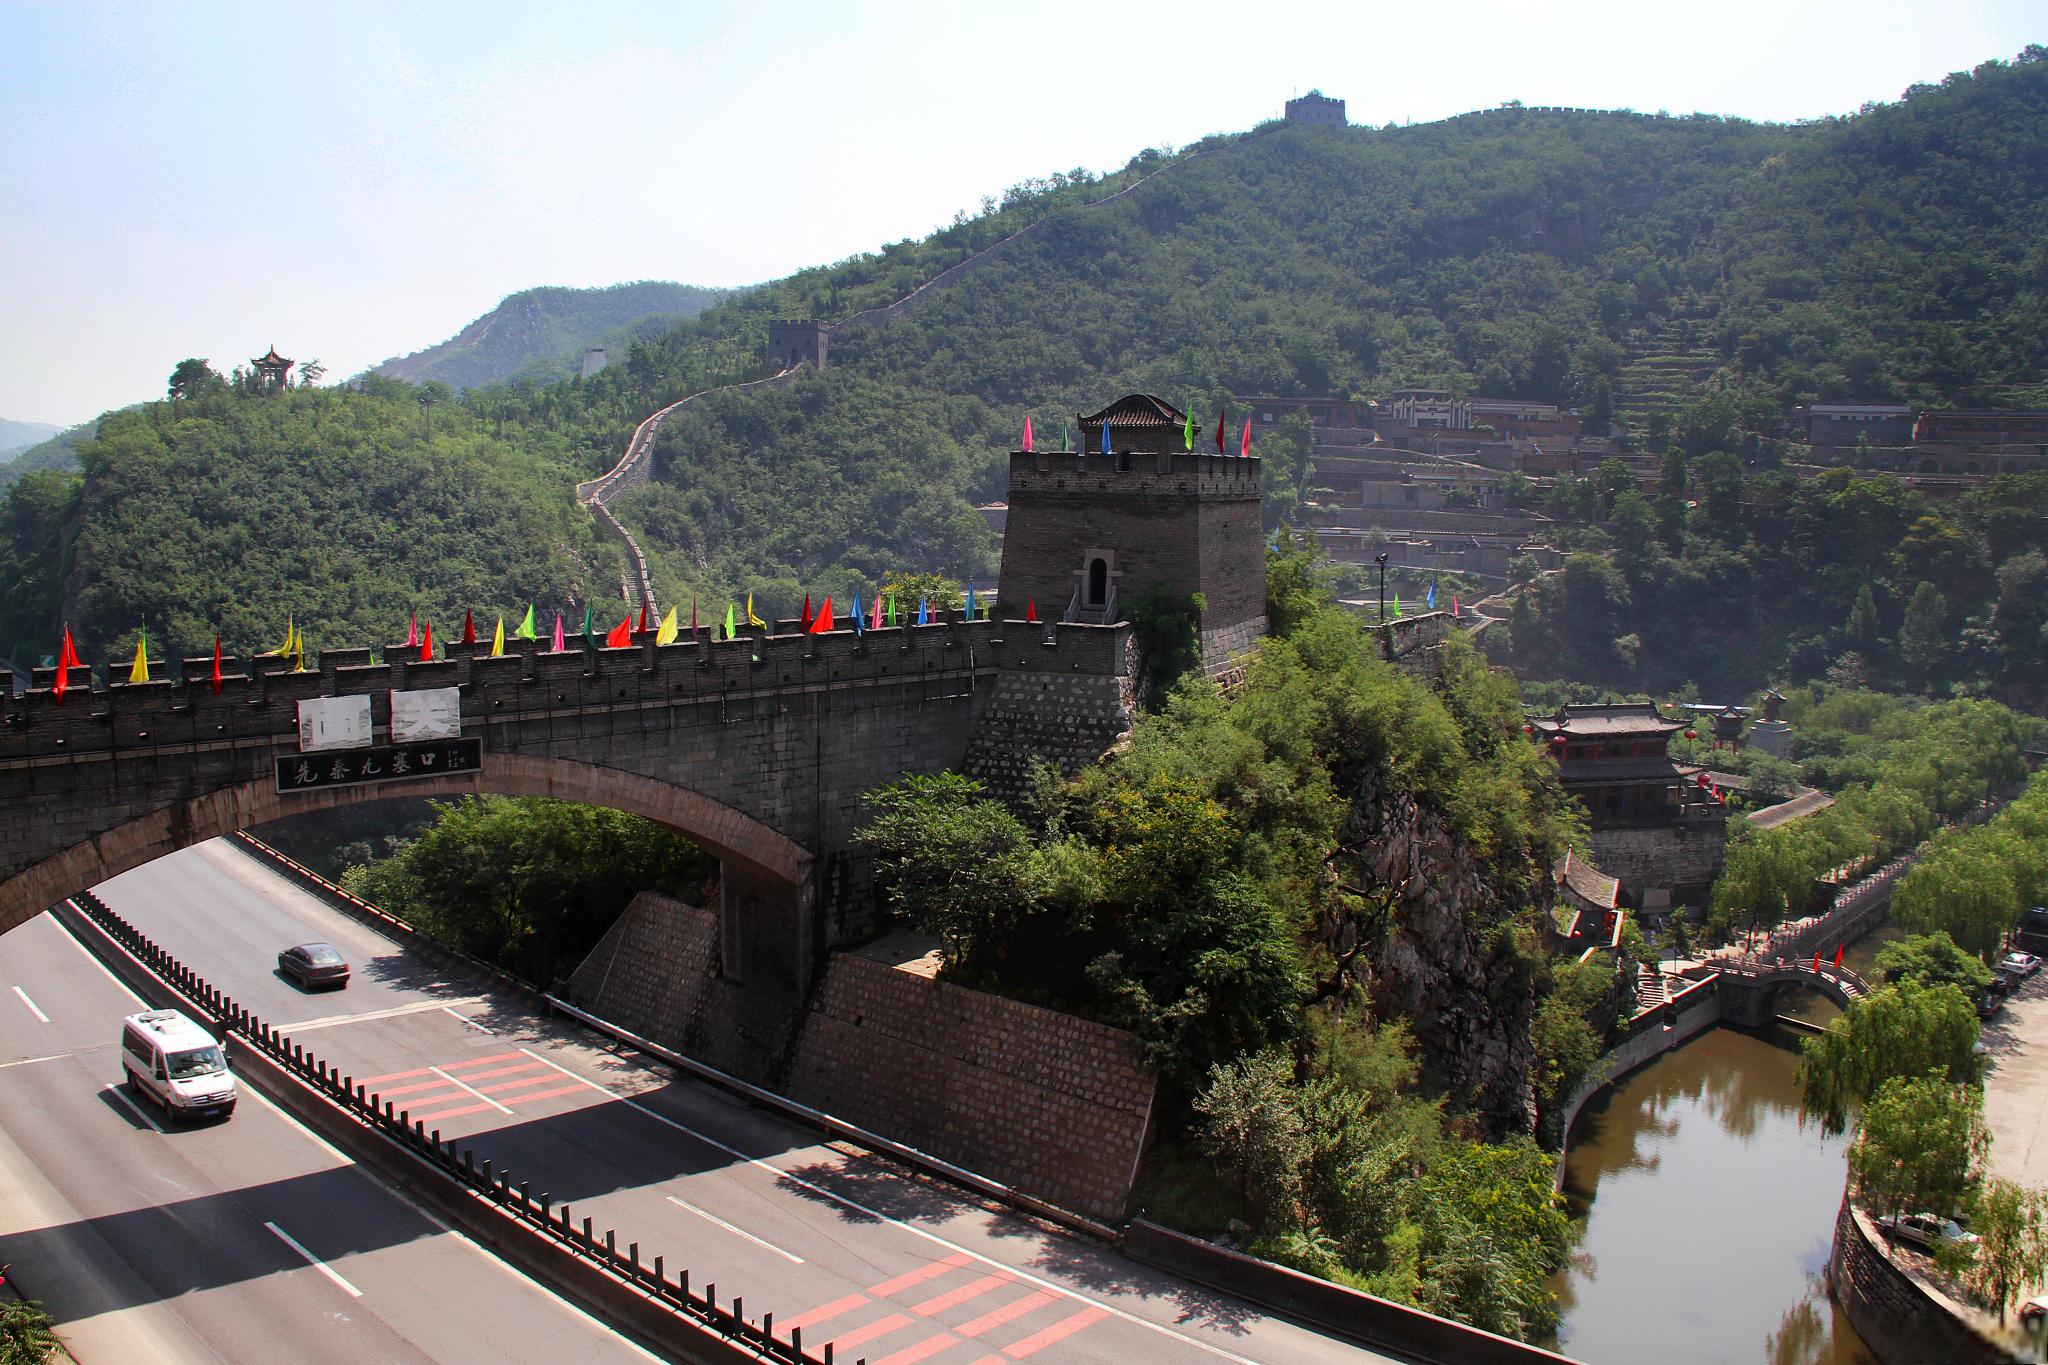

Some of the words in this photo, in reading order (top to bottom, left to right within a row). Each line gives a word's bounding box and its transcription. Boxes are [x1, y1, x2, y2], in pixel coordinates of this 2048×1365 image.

[294, 751, 437, 784] 先秦九塞口
